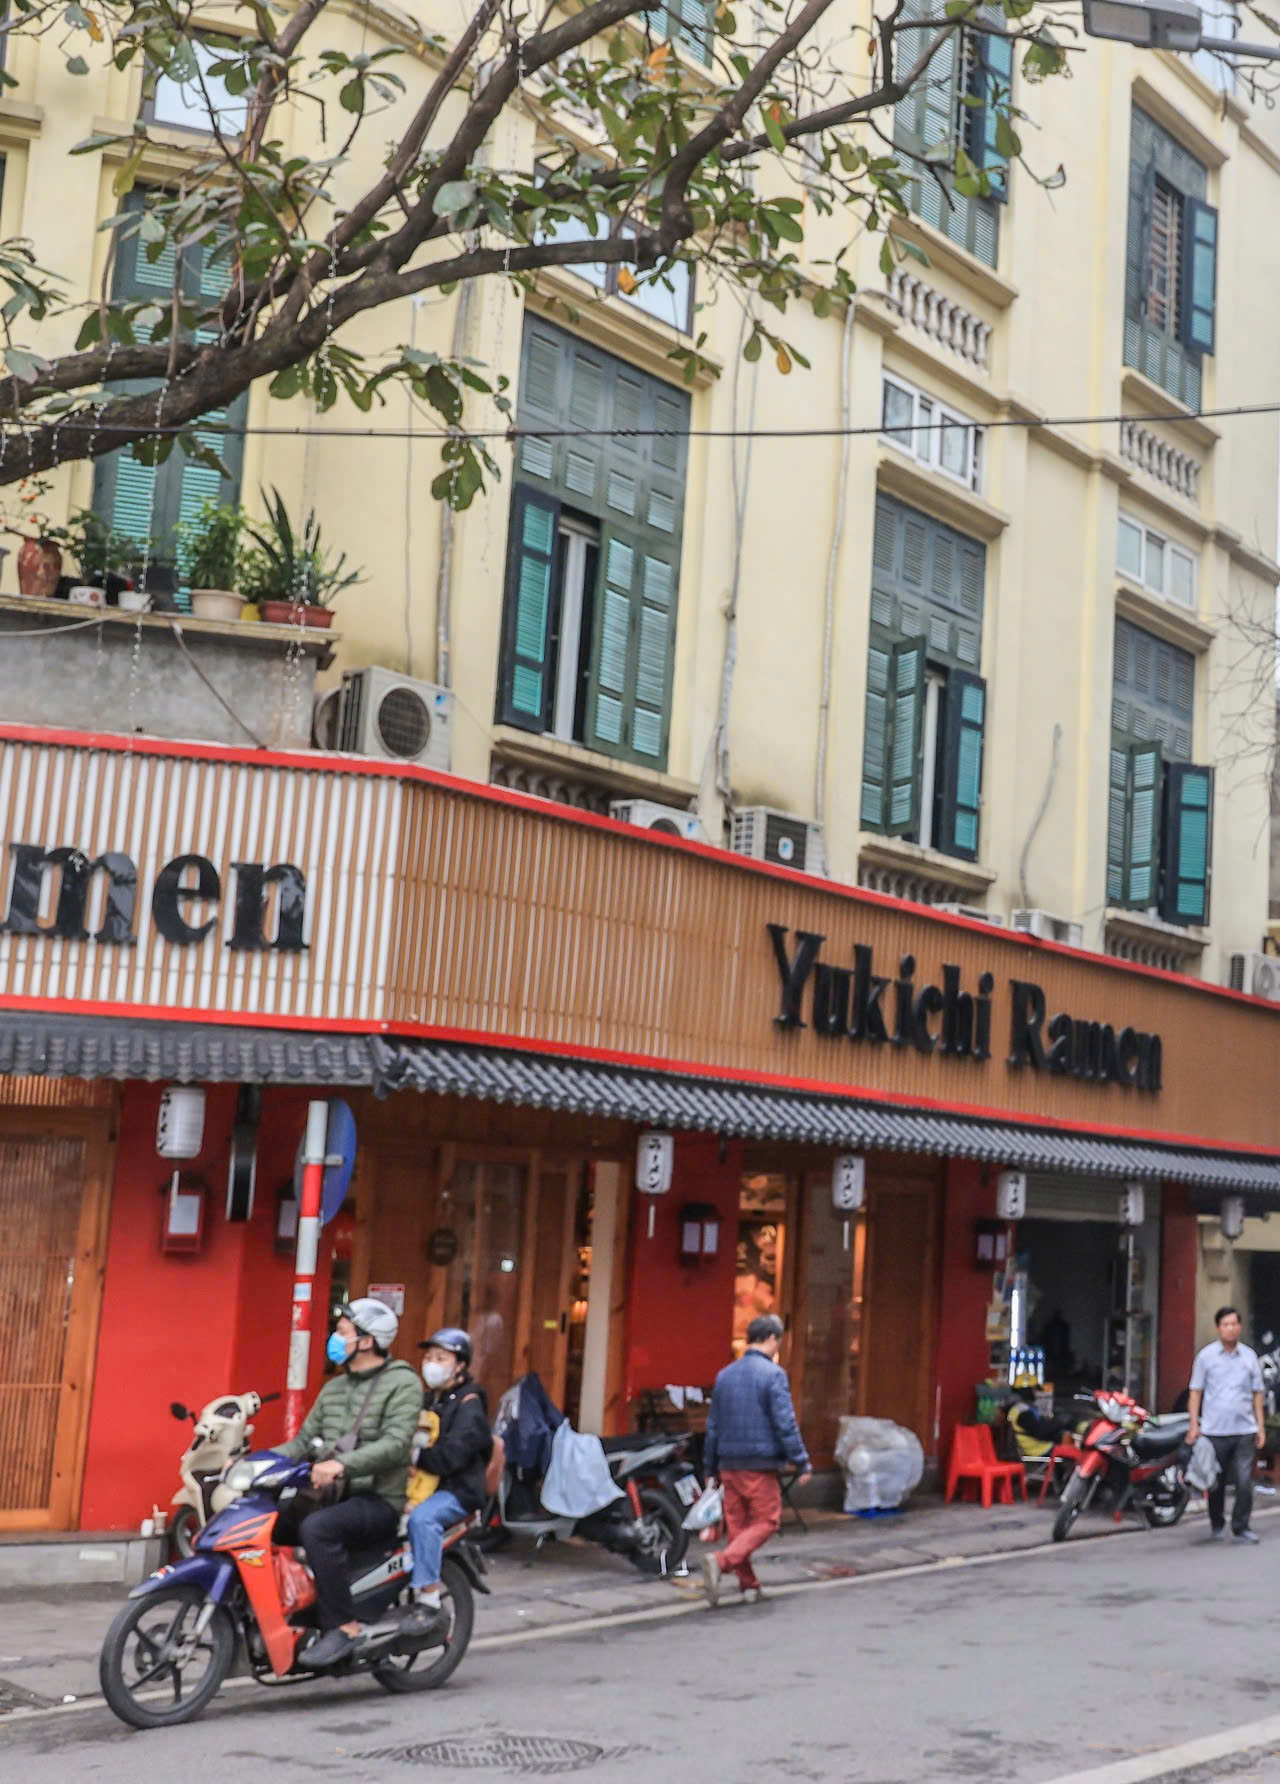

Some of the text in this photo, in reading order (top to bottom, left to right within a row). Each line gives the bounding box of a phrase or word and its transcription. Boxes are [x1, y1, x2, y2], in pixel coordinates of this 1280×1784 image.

[0, 843, 311, 952] men
[767, 922, 1163, 1092] Yukichi Ramen
